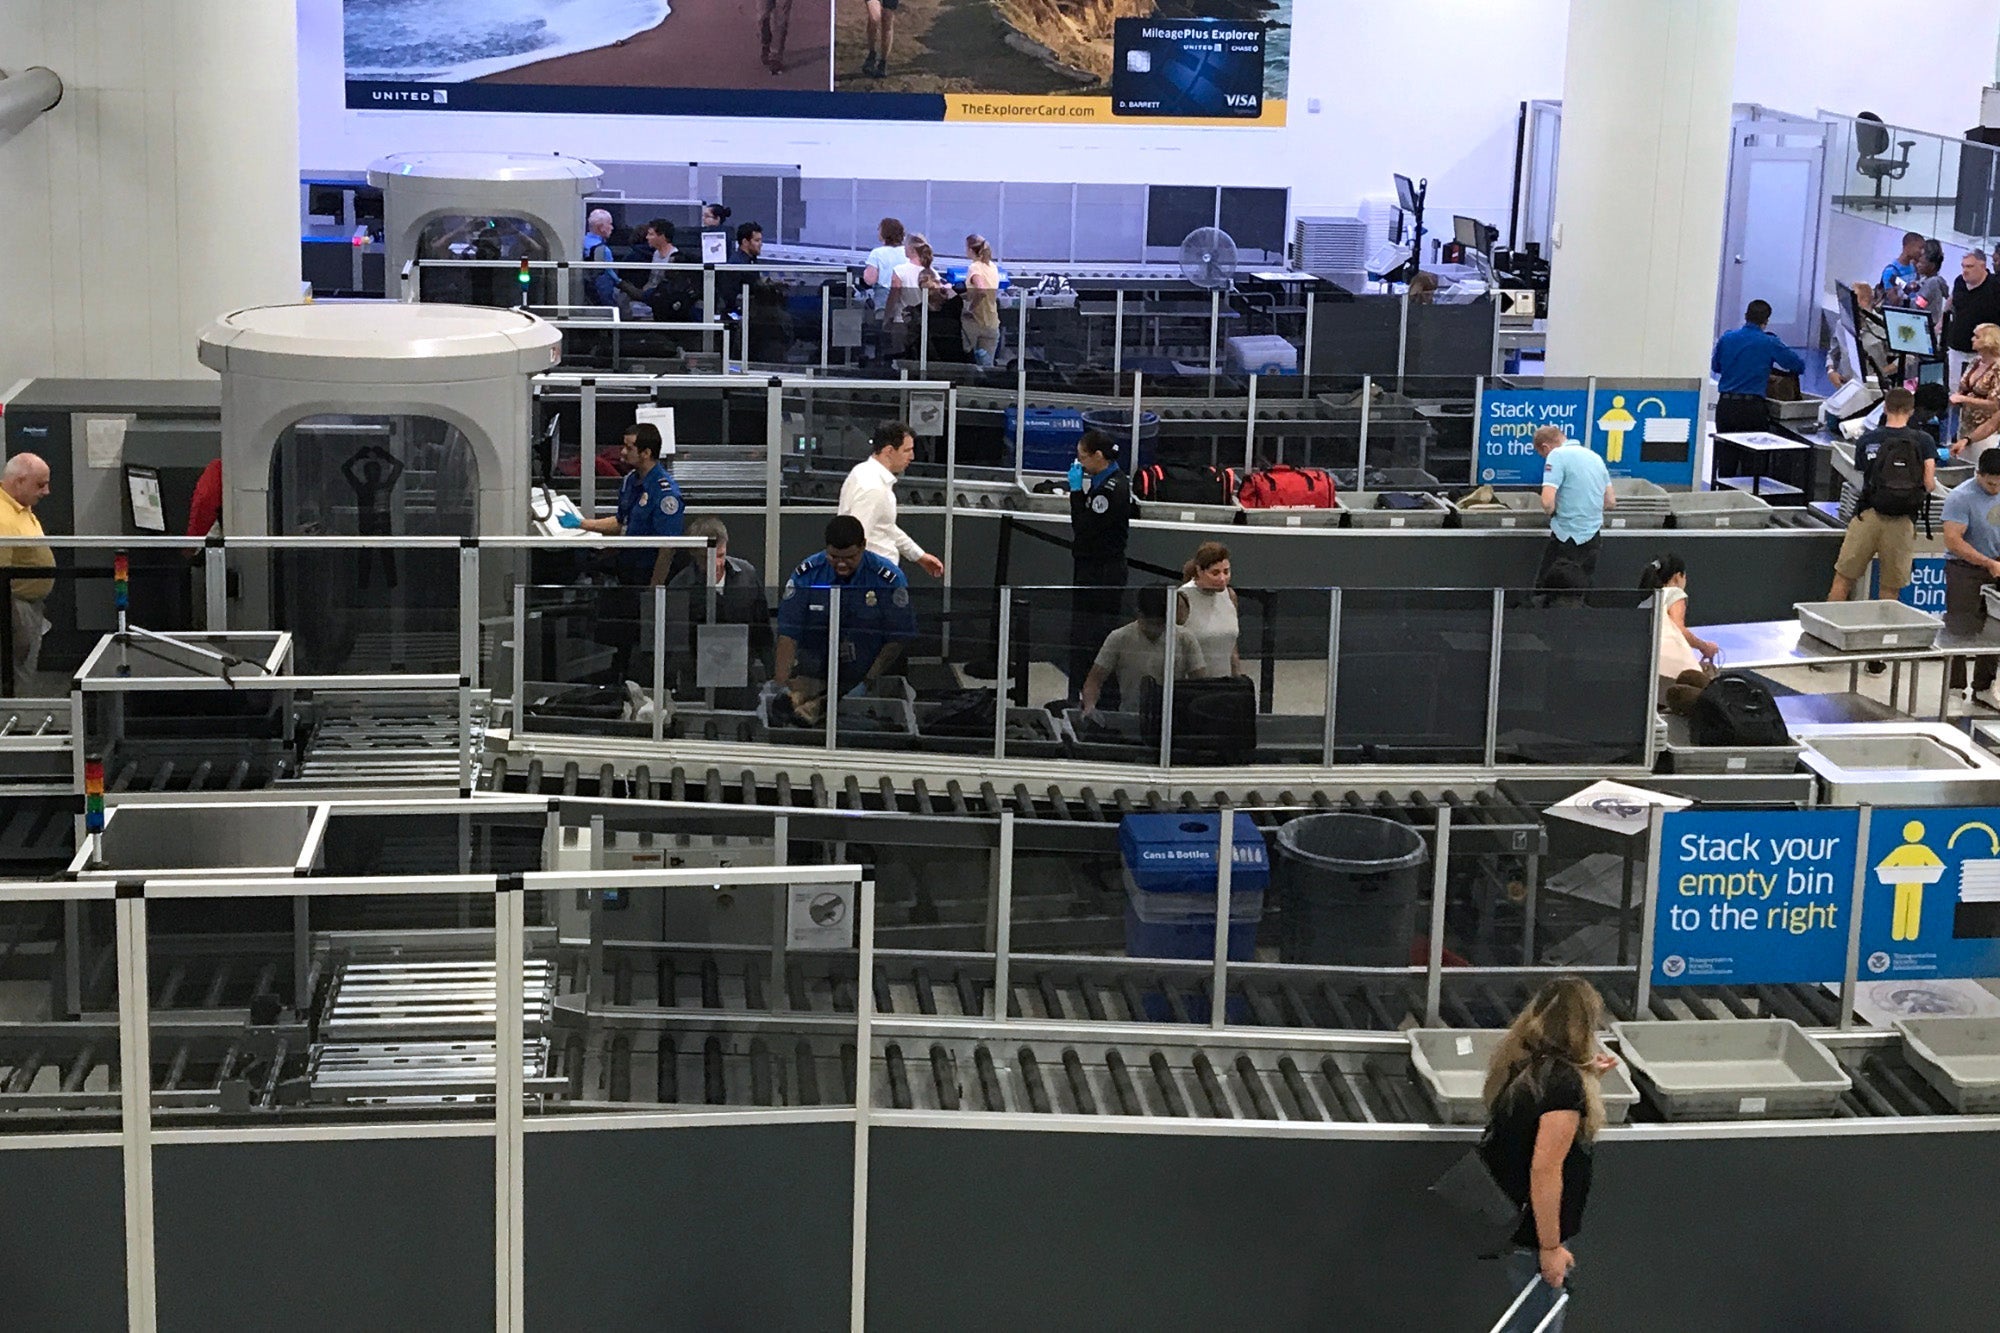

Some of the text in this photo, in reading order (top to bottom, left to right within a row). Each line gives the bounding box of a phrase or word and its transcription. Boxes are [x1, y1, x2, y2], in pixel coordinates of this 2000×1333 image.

[1142, 28, 1260, 41] MileagePlus Explorer
[372, 91, 430, 101] UNITED
[1224, 94, 1257, 107] VISA
[961, 103, 1095, 117] TheExplorerCard.com
[1490, 402, 1577, 420] Stack your
[1486, 439, 1535, 456] to the
[1143, 850, 1210, 860] Cans & Bottles
[1679, 832, 1840, 866] Stack your
[1678, 865, 1834, 900] empty bin
[1669, 901, 1838, 935] to the right
